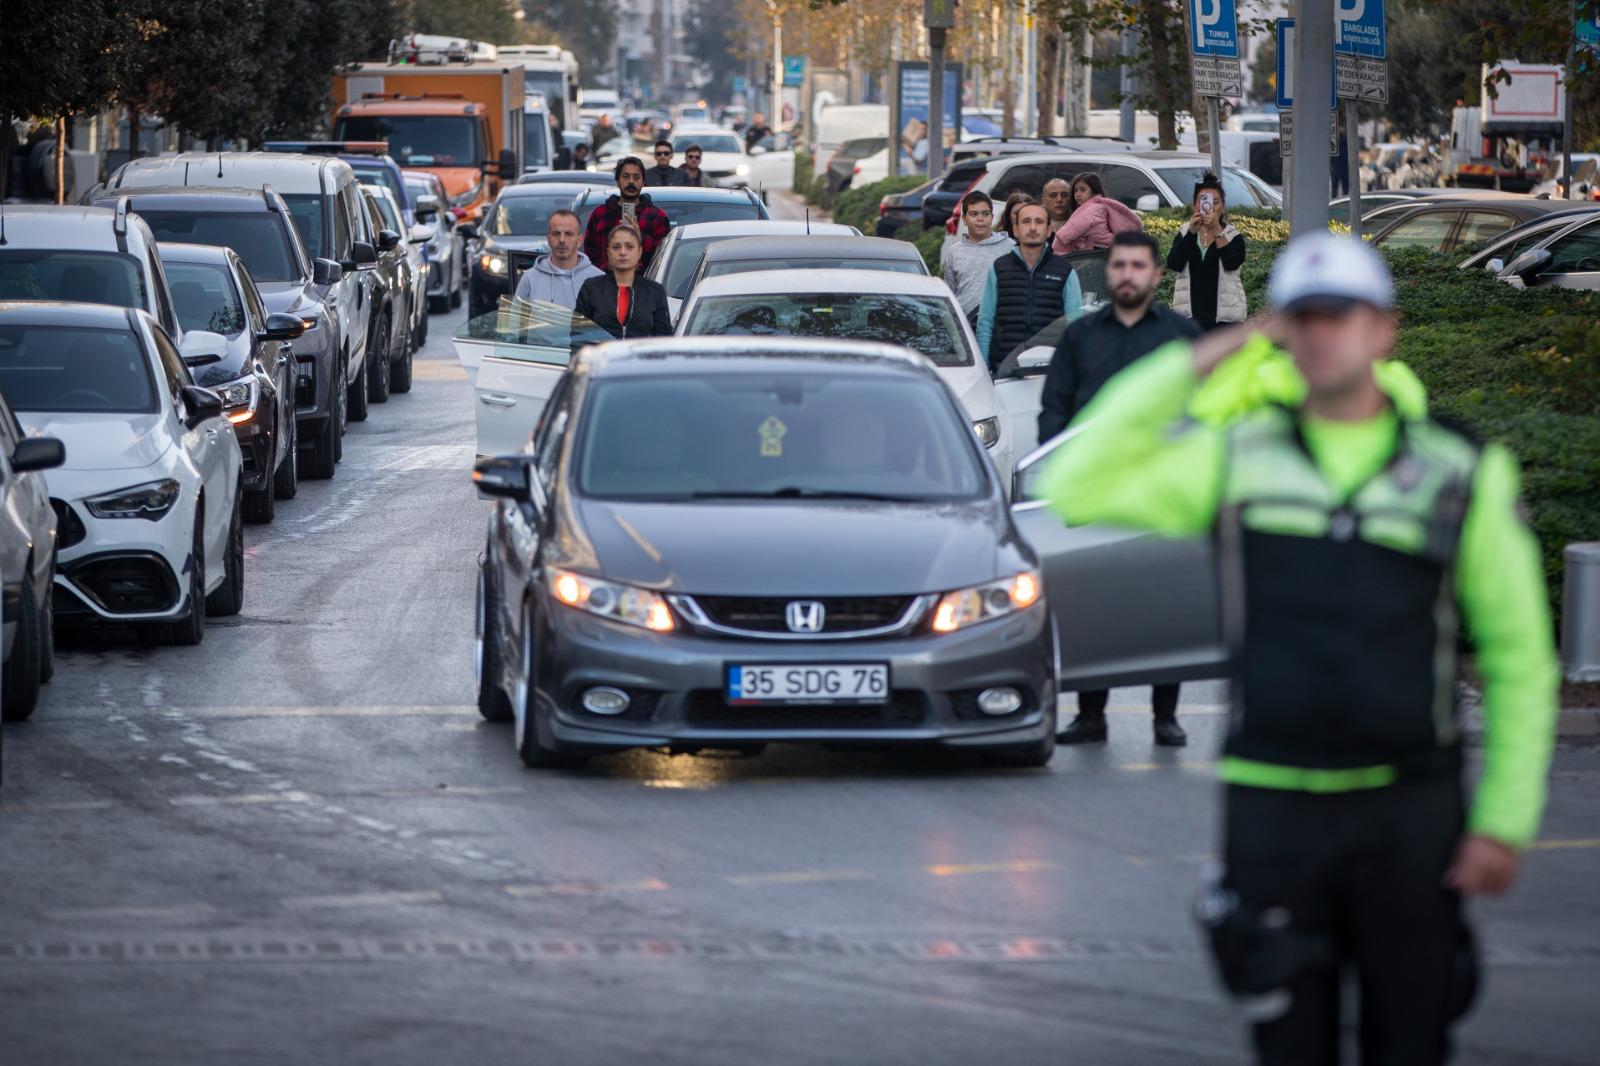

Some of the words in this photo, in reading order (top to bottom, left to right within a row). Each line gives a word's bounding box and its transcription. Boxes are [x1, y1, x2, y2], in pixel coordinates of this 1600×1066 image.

[1195, 0, 1220, 47] P
[1208, 30, 1230, 38] TUNUS
[744, 670, 774, 694] 35
[786, 670, 841, 694] SDG
[853, 669, 884, 694] 76
